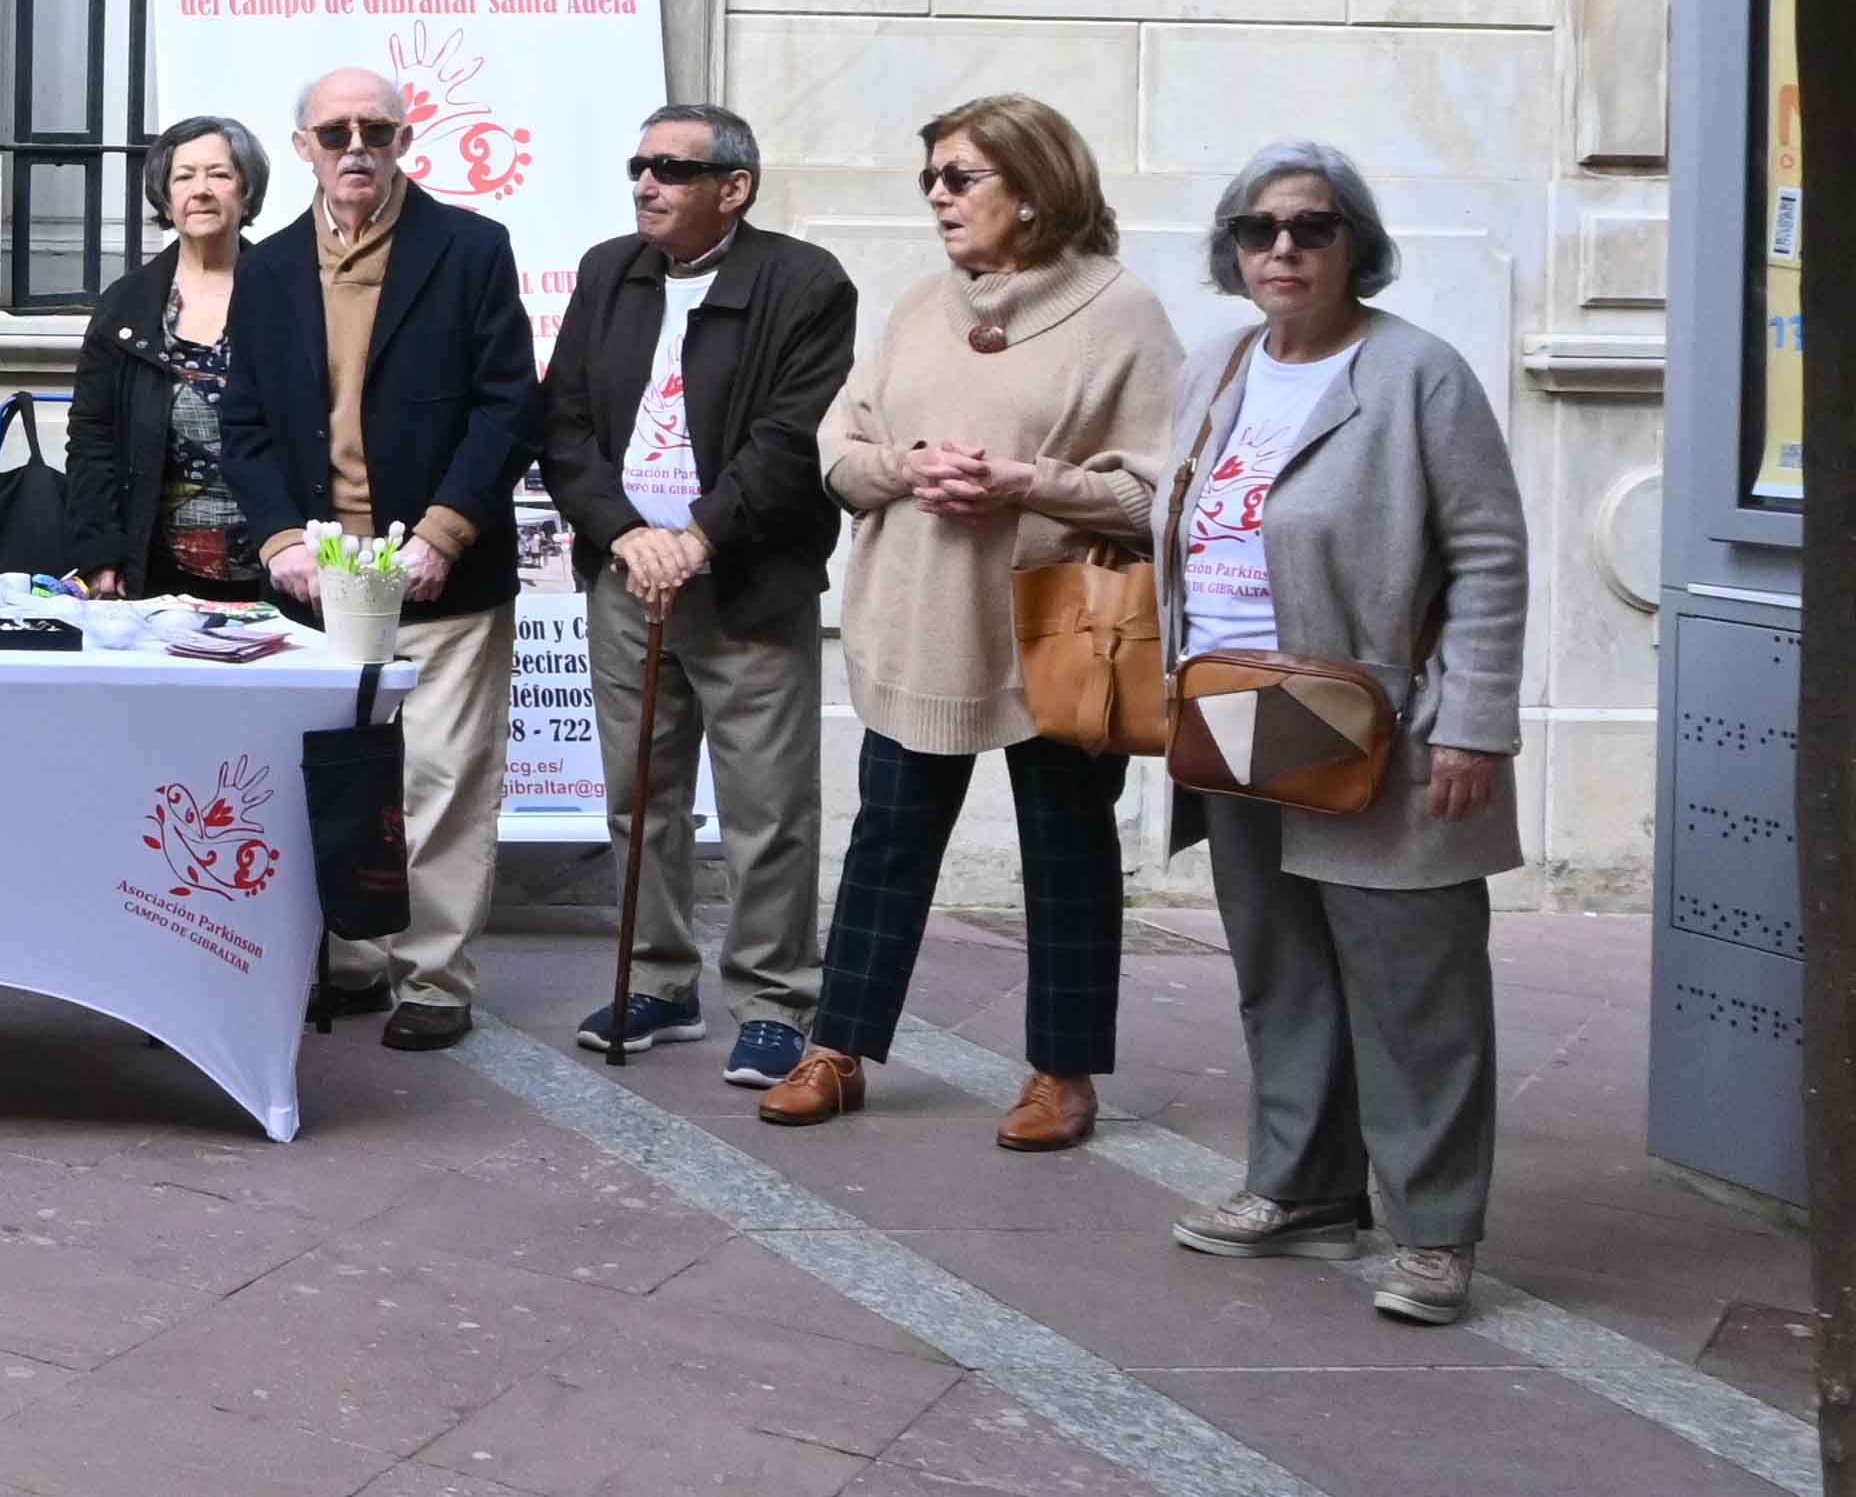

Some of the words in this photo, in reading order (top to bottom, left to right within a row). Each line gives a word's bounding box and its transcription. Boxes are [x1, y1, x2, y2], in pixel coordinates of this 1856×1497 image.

[1216, 562, 1268, 581] Parkins
[1208, 582, 1270, 598] GIBRALTA
[515, 615, 545, 640] ón
[553, 618, 564, 643] y
[573, 616, 588, 640] C
[511, 651, 588, 677] geciras
[509, 682, 593, 708] léfonos
[507, 718, 526, 742] 8
[549, 718, 593, 742] 722
[500, 779, 607, 799] gibraltar@g
[117, 879, 195, 922] Asociación
[198, 914, 264, 958] Parkinson
[124, 901, 168, 927] CAMPO
[170, 922, 187, 938] DE
[189, 931, 251, 974] GIBRALTAR
